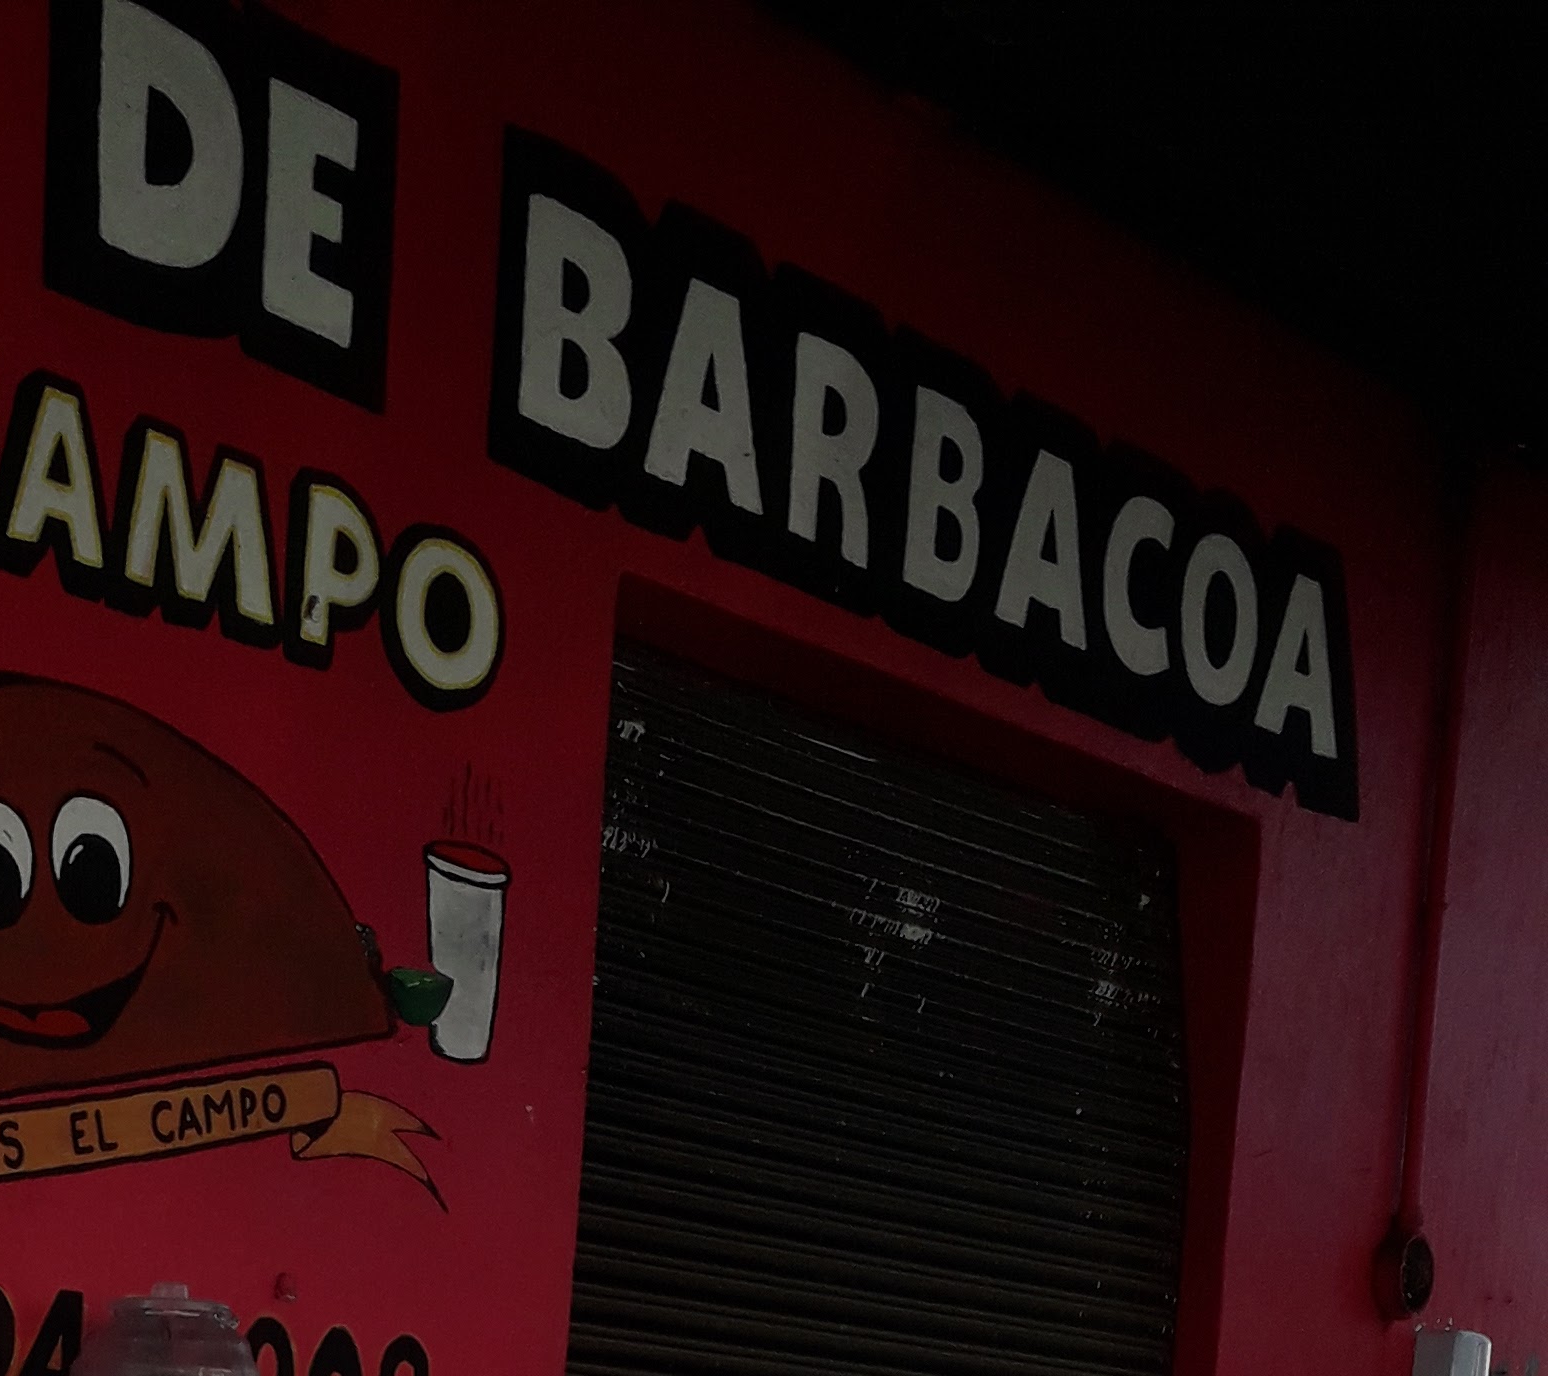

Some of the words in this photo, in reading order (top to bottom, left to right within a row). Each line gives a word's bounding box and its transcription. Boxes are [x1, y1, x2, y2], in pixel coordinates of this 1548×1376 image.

[98, 0, 358, 349] DE
[517, 192, 1338, 760] BARBACOA
[69, 1108, 120, 1157] EL
[150, 1083, 288, 1145] CAMPO
